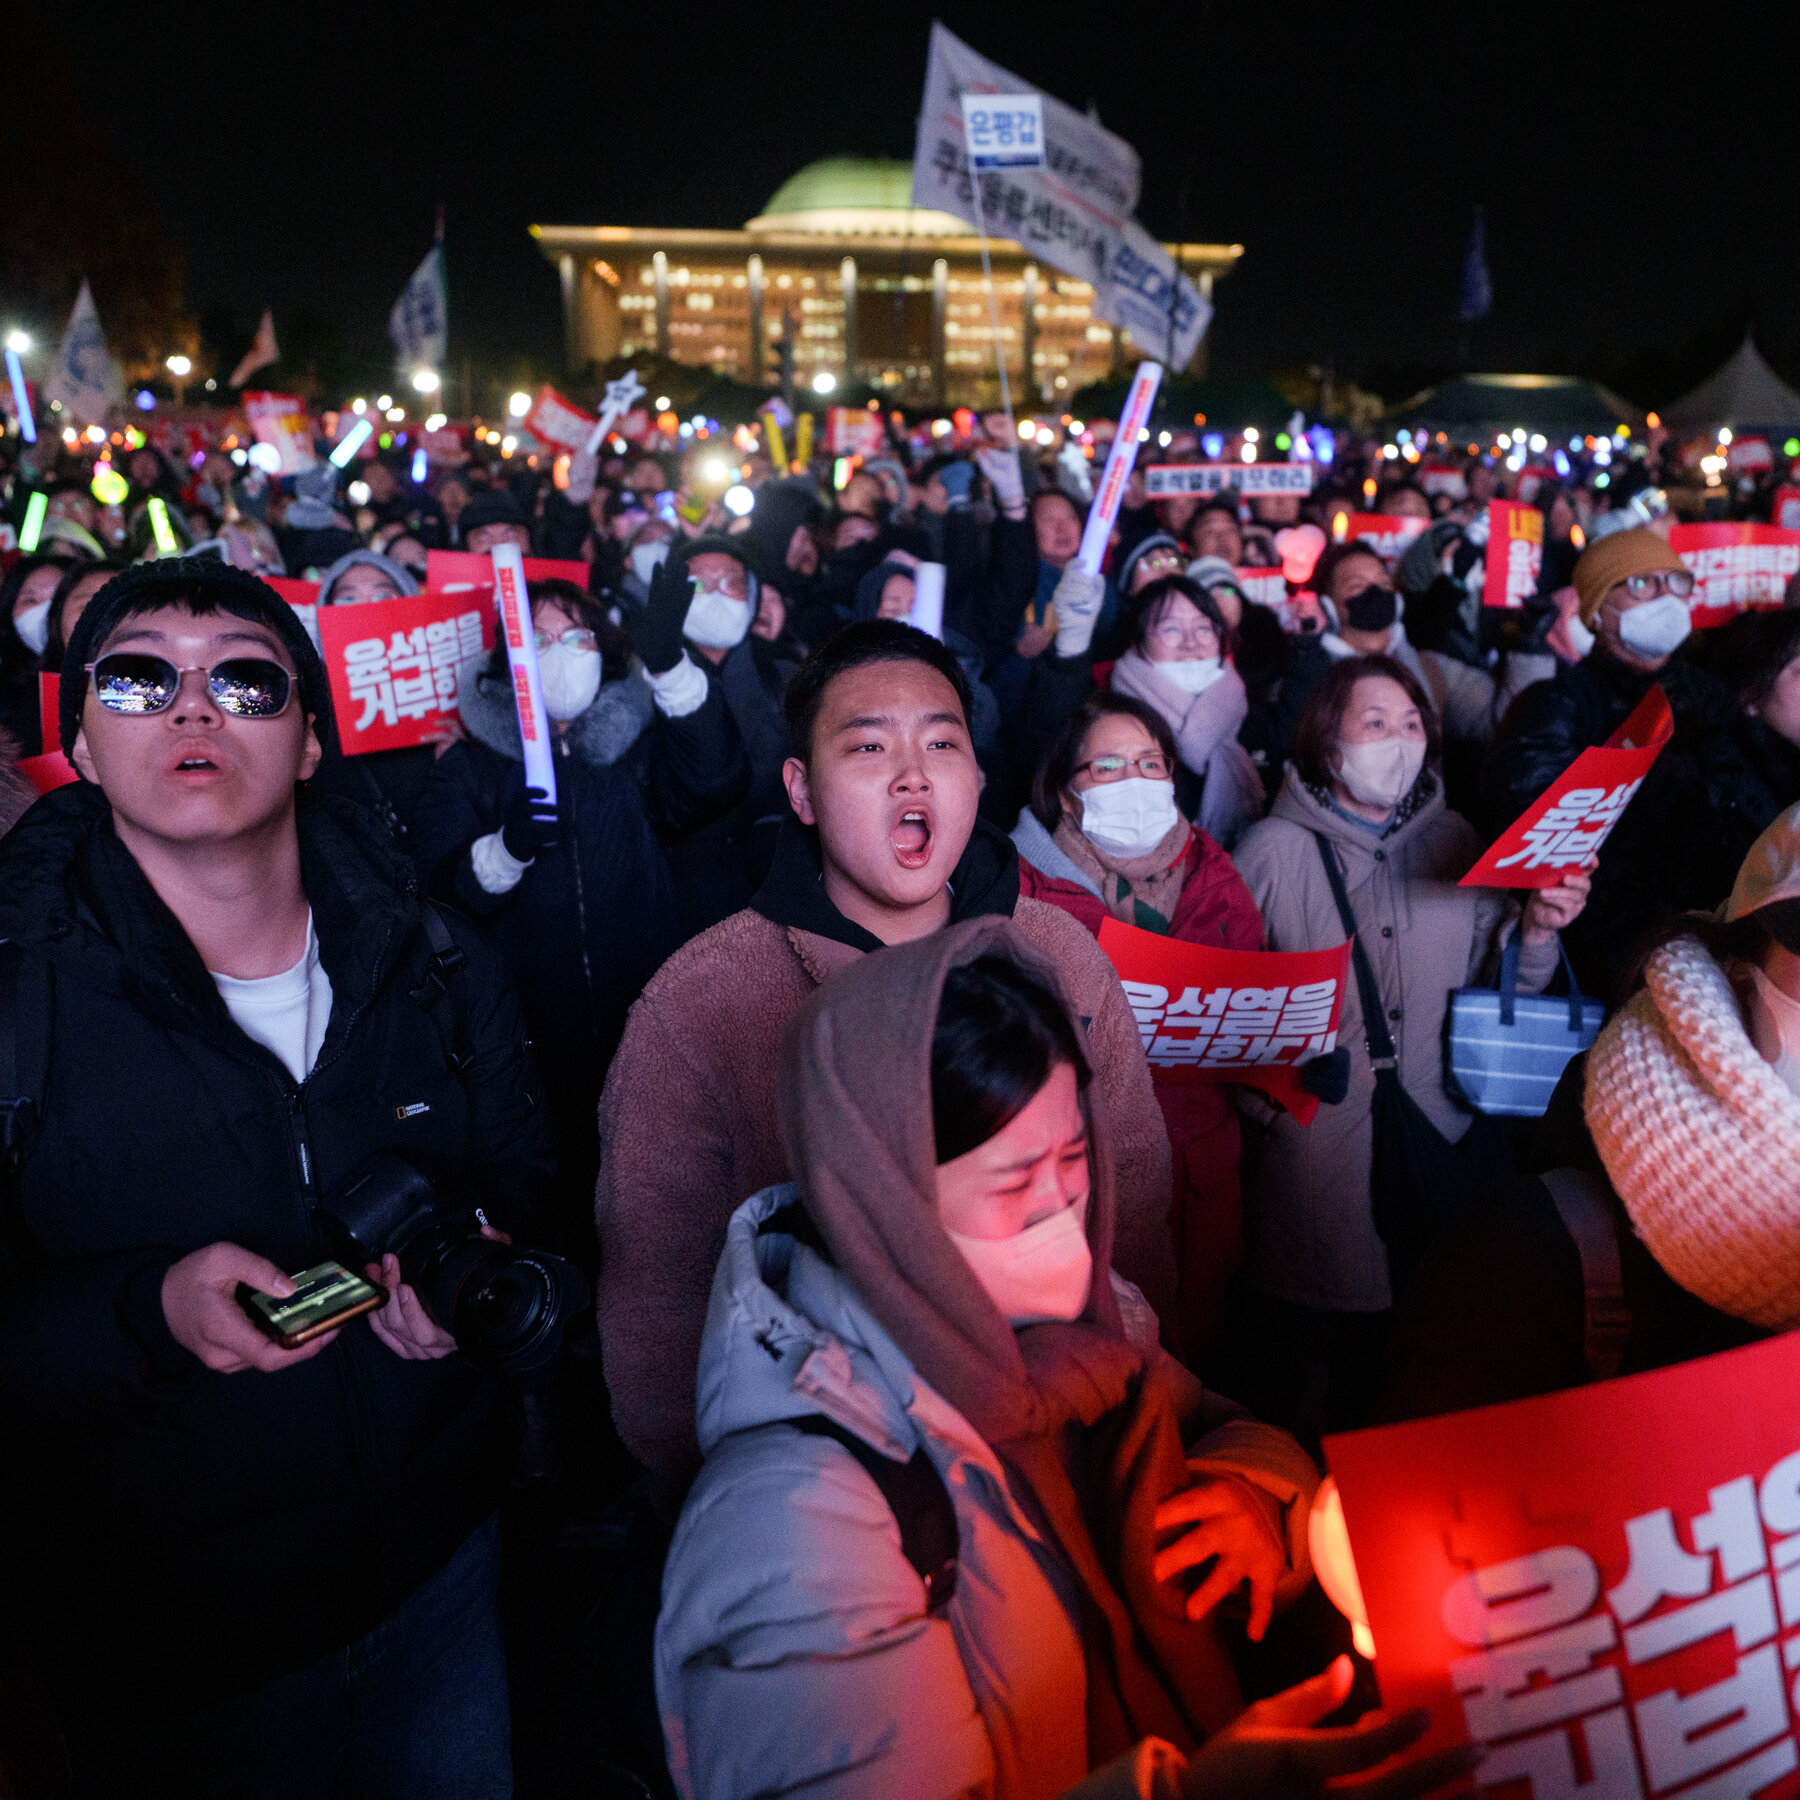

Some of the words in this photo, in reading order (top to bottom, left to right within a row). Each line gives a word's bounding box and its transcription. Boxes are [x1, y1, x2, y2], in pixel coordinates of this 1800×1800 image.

[970, 111, 1036, 146] 은평갑
[344, 610, 484, 690] 윤석열을
[351, 663, 461, 731] 거부한
[1533, 775, 1646, 831] 윤석
[1495, 826, 1611, 869] 거부
[1120, 978, 1338, 1036] 윤석열을
[1138, 1030, 1338, 1068] 부한다
[475, 1208, 489, 1226] Can
